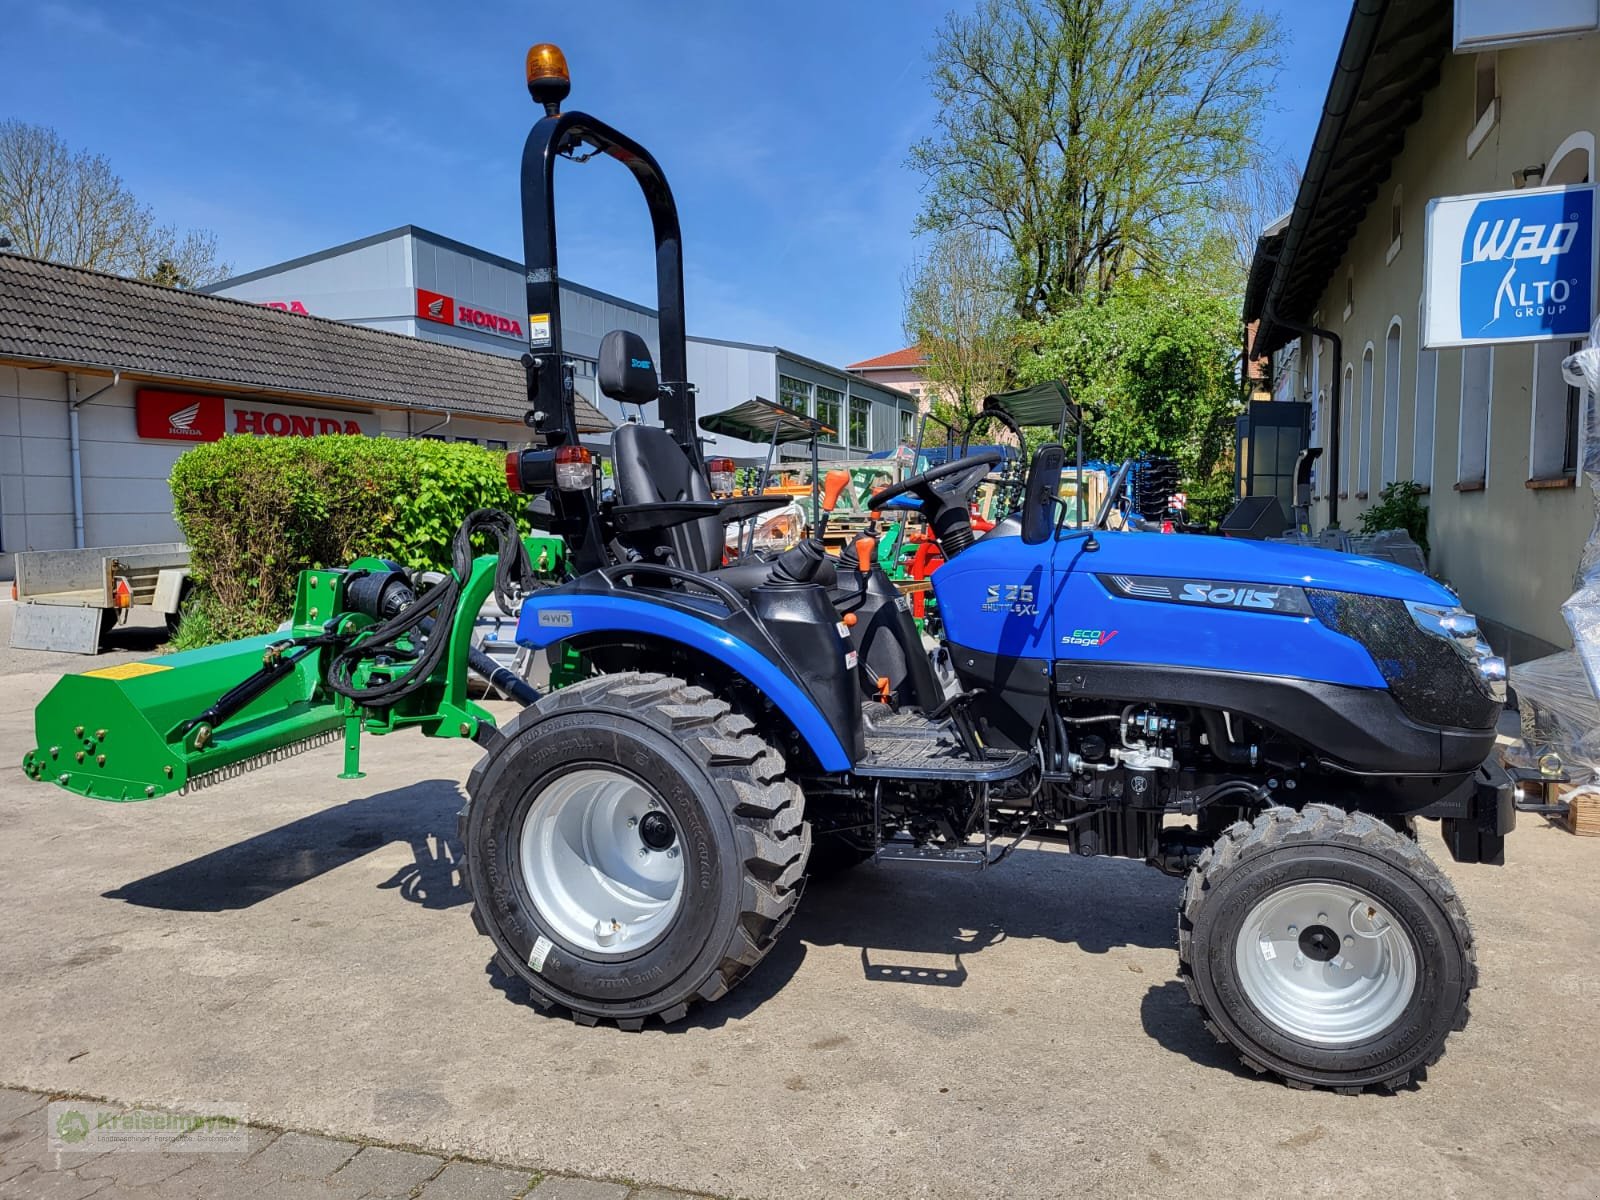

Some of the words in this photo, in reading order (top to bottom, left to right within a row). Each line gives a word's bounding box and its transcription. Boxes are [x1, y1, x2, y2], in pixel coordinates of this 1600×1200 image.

[1473, 218, 1579, 264] Wap
[1494, 266, 1570, 319] ALTO
[458, 306, 523, 336] HONDA
[1515, 304, 1567, 318] GROUP
[168, 428, 202, 436] HONDA
[233, 409, 361, 437] HONDA
[542, 614, 570, 623] 4WD
[1073, 629, 1101, 638] ECO
